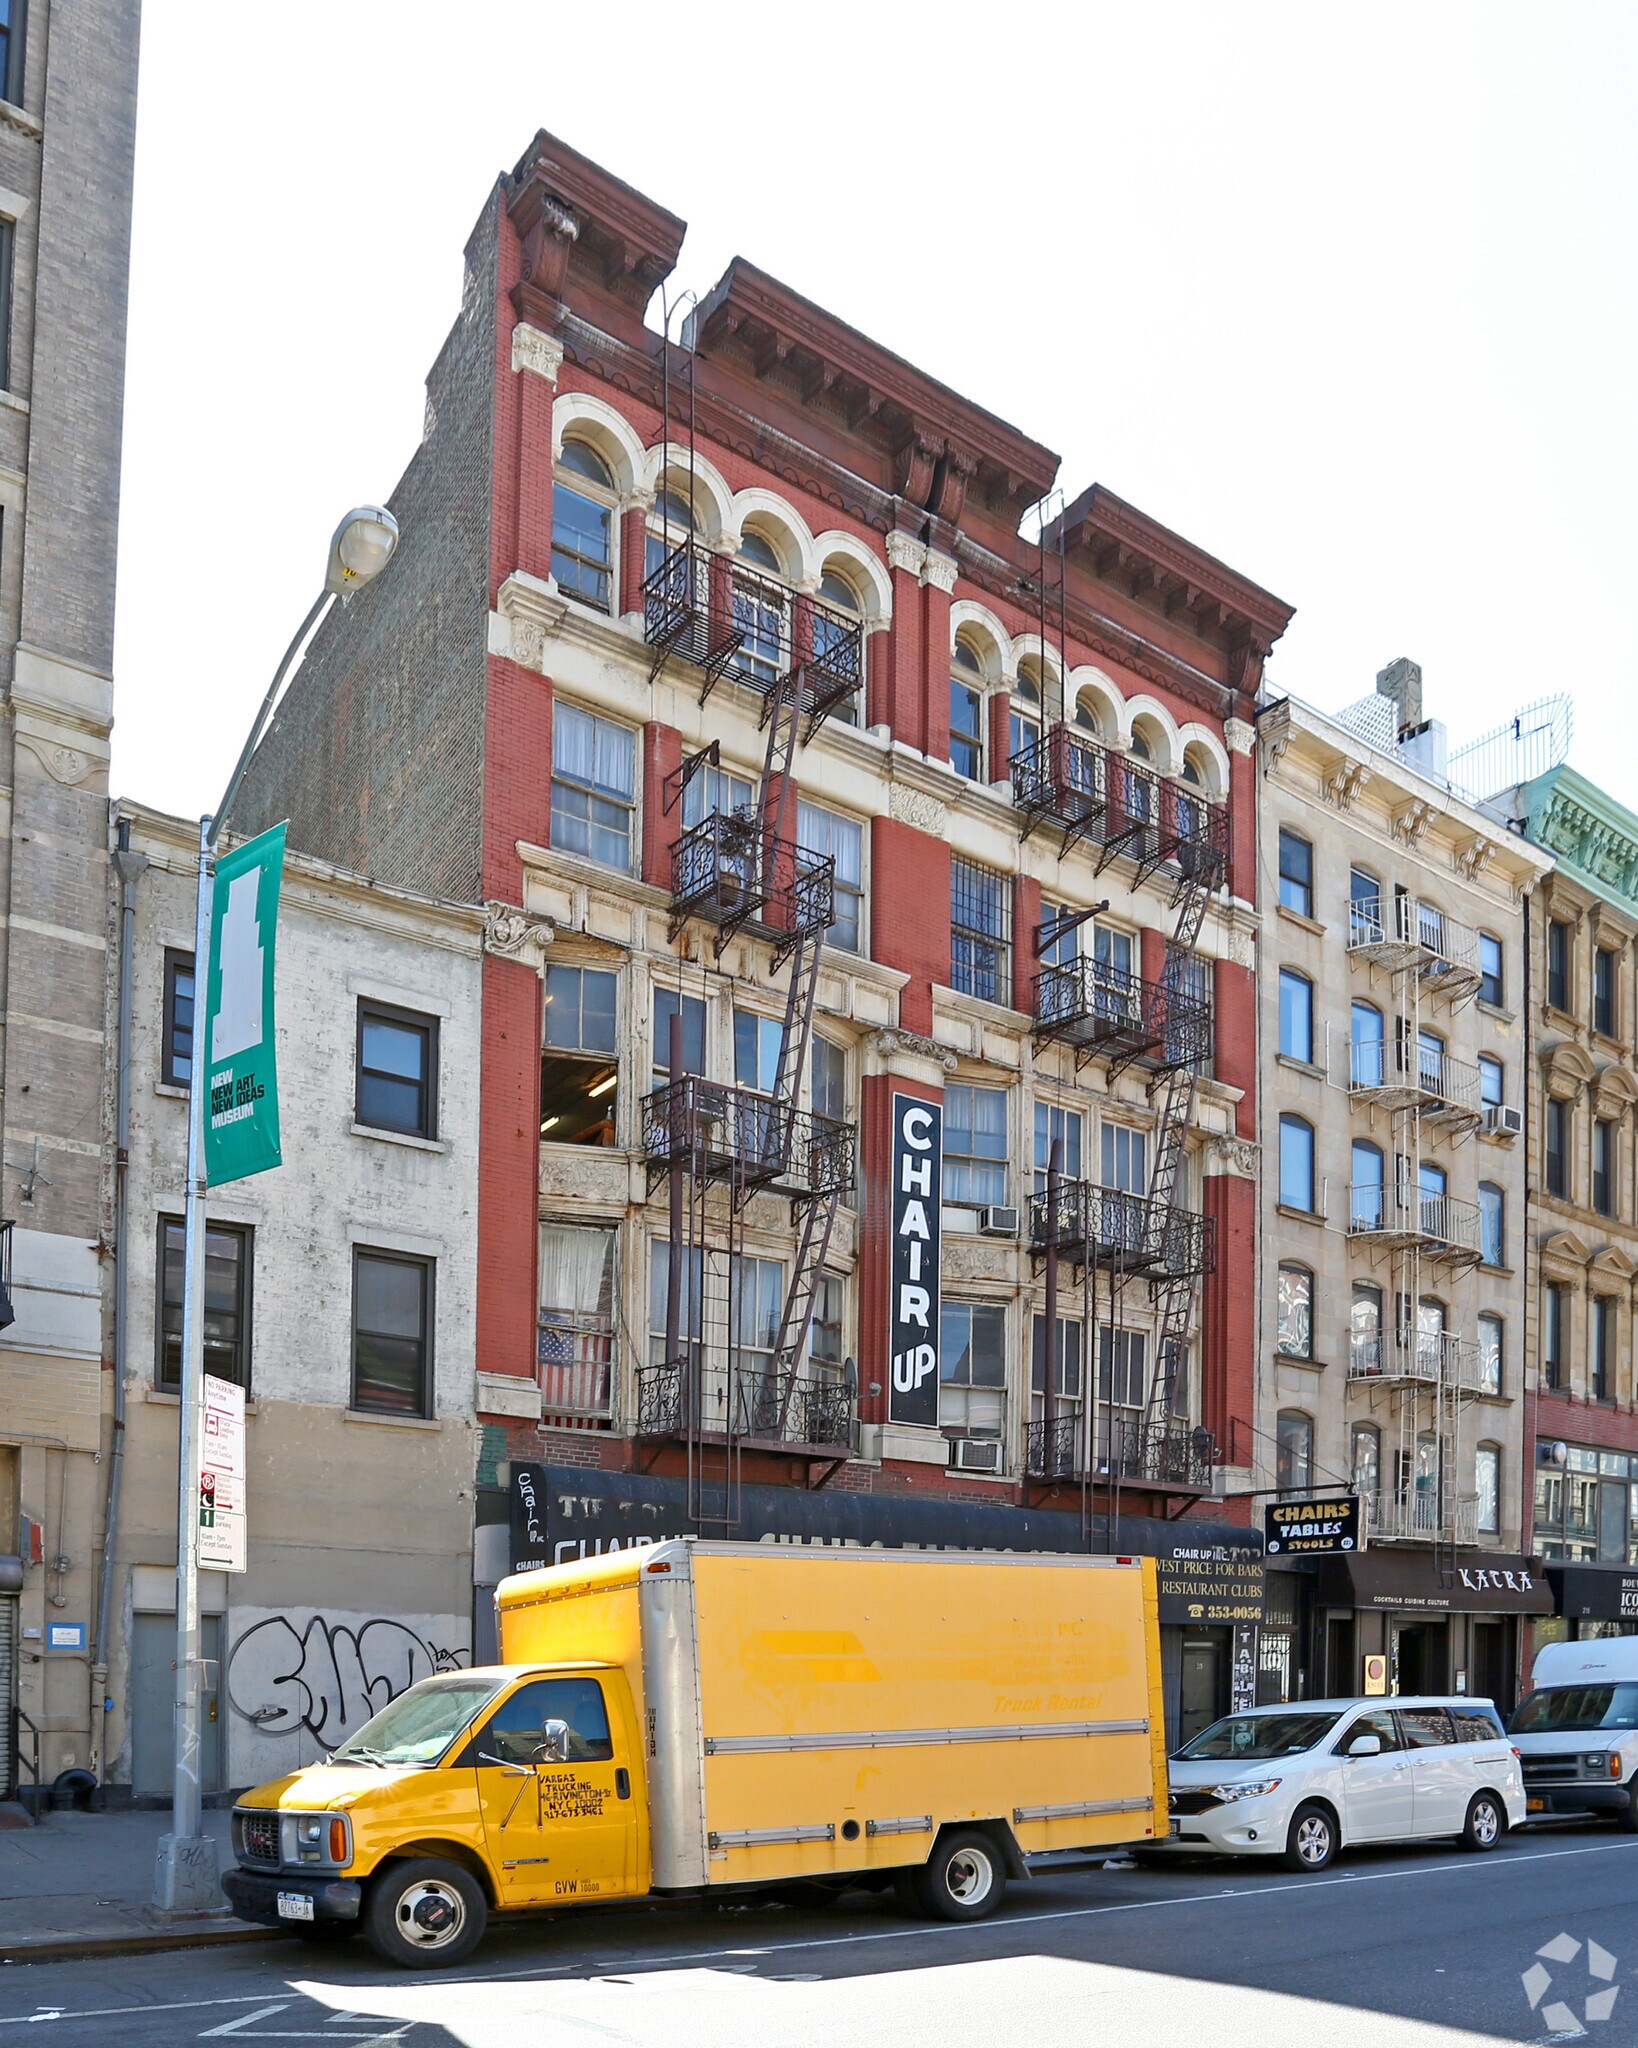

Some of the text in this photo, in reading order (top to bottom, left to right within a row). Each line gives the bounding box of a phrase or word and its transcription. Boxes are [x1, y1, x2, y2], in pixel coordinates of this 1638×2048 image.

[211, 1068, 233, 1090] NEW
[212, 1073, 255, 1103] NEW ART
[212, 1084, 264, 1116] NEW IDEAS
[212, 1102, 254, 1130] MUSEUM
[899, 1106, 934, 1328] CHAIR
[893, 1343, 936, 1393] UP
[208, 1381, 236, 1396] NO PARKING
[208, 1389, 226, 1402] Anytime
[205, 1510, 209, 1526] 1
[1273, 1503, 1350, 1522] CHAIRS
[1280, 1522, 1342, 1538] TABLES
[1288, 1539, 1334, 1550] STOOLS
[1173, 1548, 1199, 1560] CHAIR
[1200, 1550, 1212, 1560] UP
[516, 1560, 545, 1571] CHAIRS
[1184, 1562, 1212, 1575] PRICE
[1216, 1563, 1236, 1576] FOR
[1238, 1564, 1264, 1578] BARS
[1458, 1568, 1532, 1592] KATRA
[1162, 1581, 1262, 1598] RESTAURANT CLUBS
[1208, 1605, 1262, 1620] 353-0056
[994, 1692, 1104, 1713] Truck Rental
[545, 1782, 592, 1792] TRUCKING
[555, 1880, 578, 1894] GVW
[581, 1883, 600, 1892] 10000
